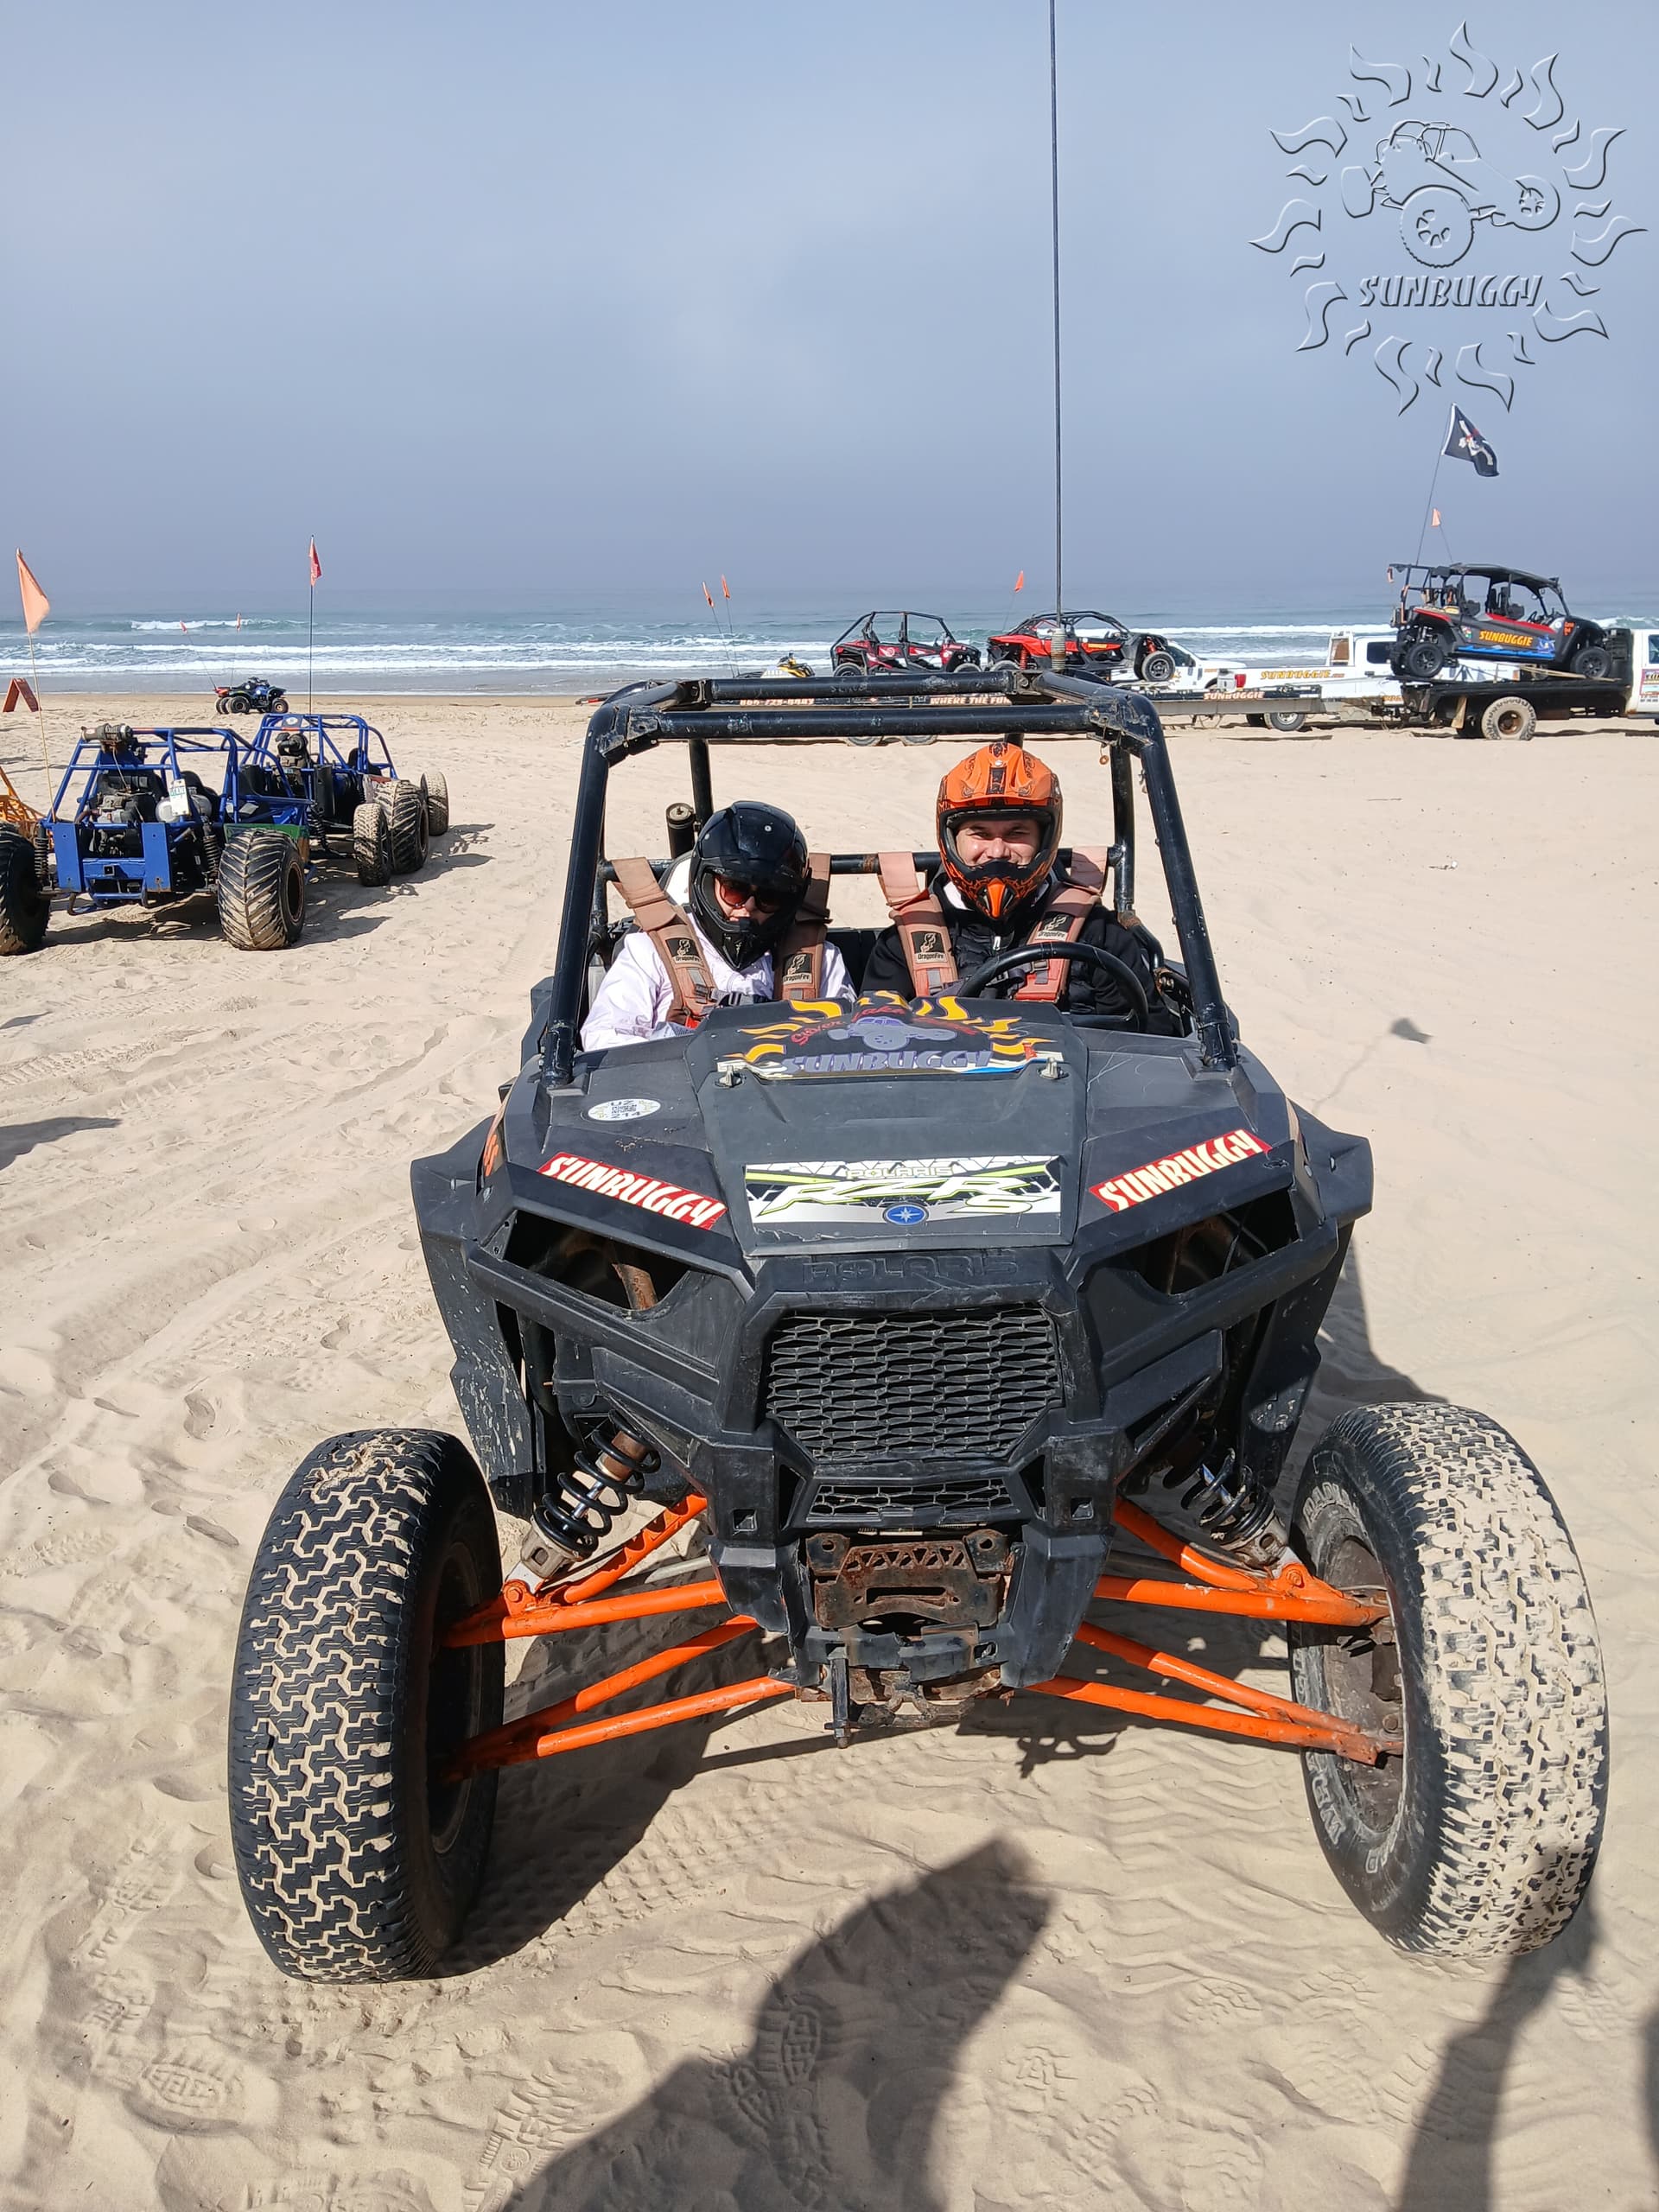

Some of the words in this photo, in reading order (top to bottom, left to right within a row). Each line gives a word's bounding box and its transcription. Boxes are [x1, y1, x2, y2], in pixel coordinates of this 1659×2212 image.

[1479, 630, 1534, 646] SUNBUGGIE
[930, 696, 966, 705] WHERE
[917, 952, 944, 961] DragonFire
[780, 1049, 993, 1075] SUNBUGGY
[847, 1166, 957, 1180] POLARIS
[1098, 1128, 1264, 1211] SUNBUGGY
[542, 1156, 728, 1227] SUNBUGGY
[757, 1176, 1033, 1217] RZR
[802, 1255, 1019, 1281] POLARIS
